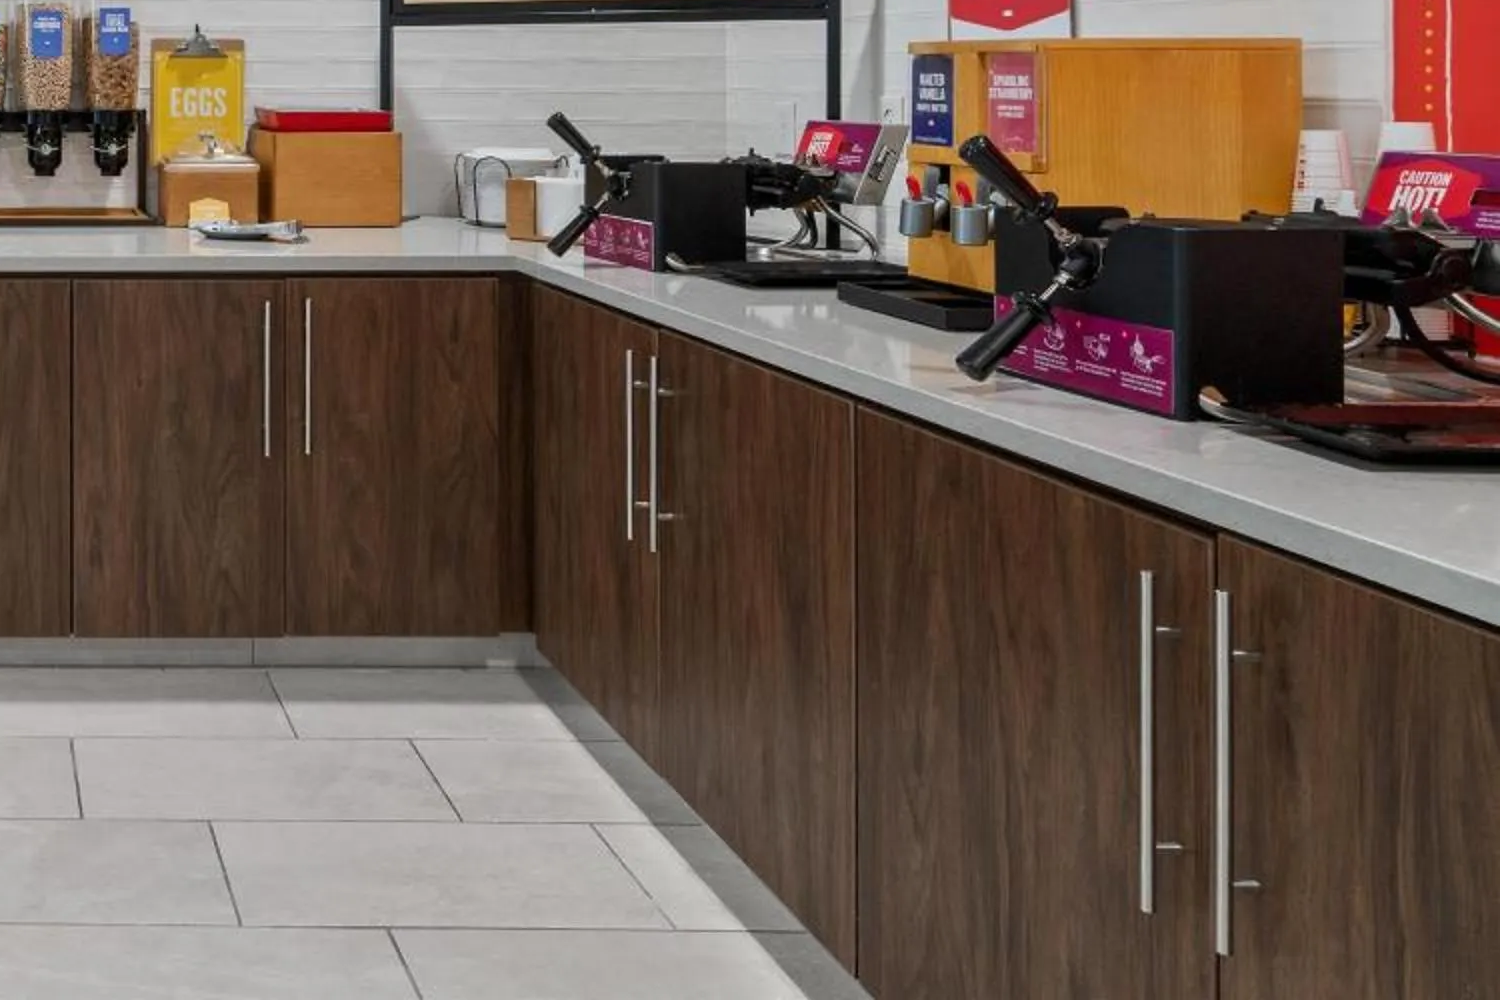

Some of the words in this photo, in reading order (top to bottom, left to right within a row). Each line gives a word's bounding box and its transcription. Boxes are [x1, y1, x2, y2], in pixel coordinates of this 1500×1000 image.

[169, 87, 228, 118] EGGS
[1400, 169, 1453, 186] CAUTION
[1388, 185, 1448, 213] HOT!
